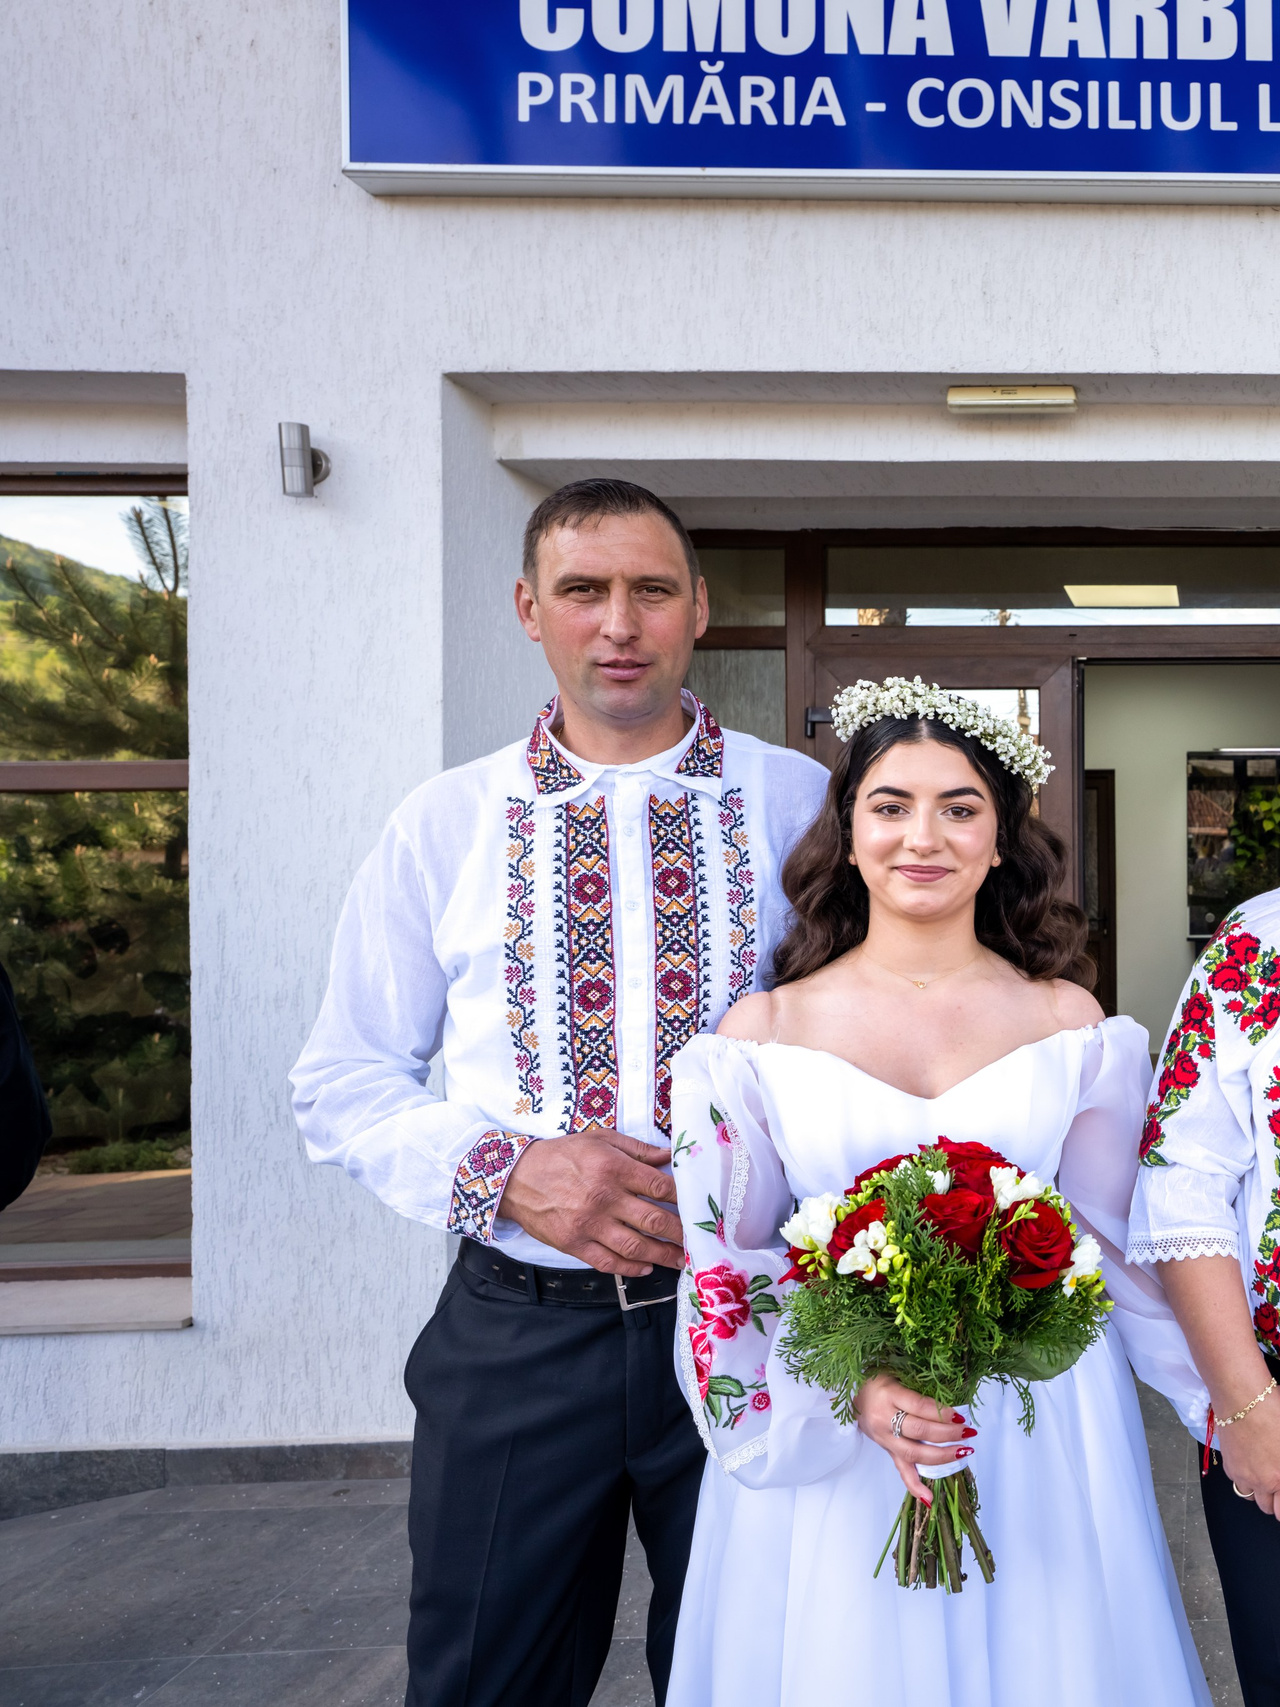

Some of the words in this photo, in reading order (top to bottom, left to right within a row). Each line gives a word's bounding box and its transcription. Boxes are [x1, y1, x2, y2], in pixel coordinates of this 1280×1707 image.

[517, 60, 847, 126] PRIMĂRIA
[865, 102, 887, 112] -
[907, 77, 1238, 131] CONSILIUL
